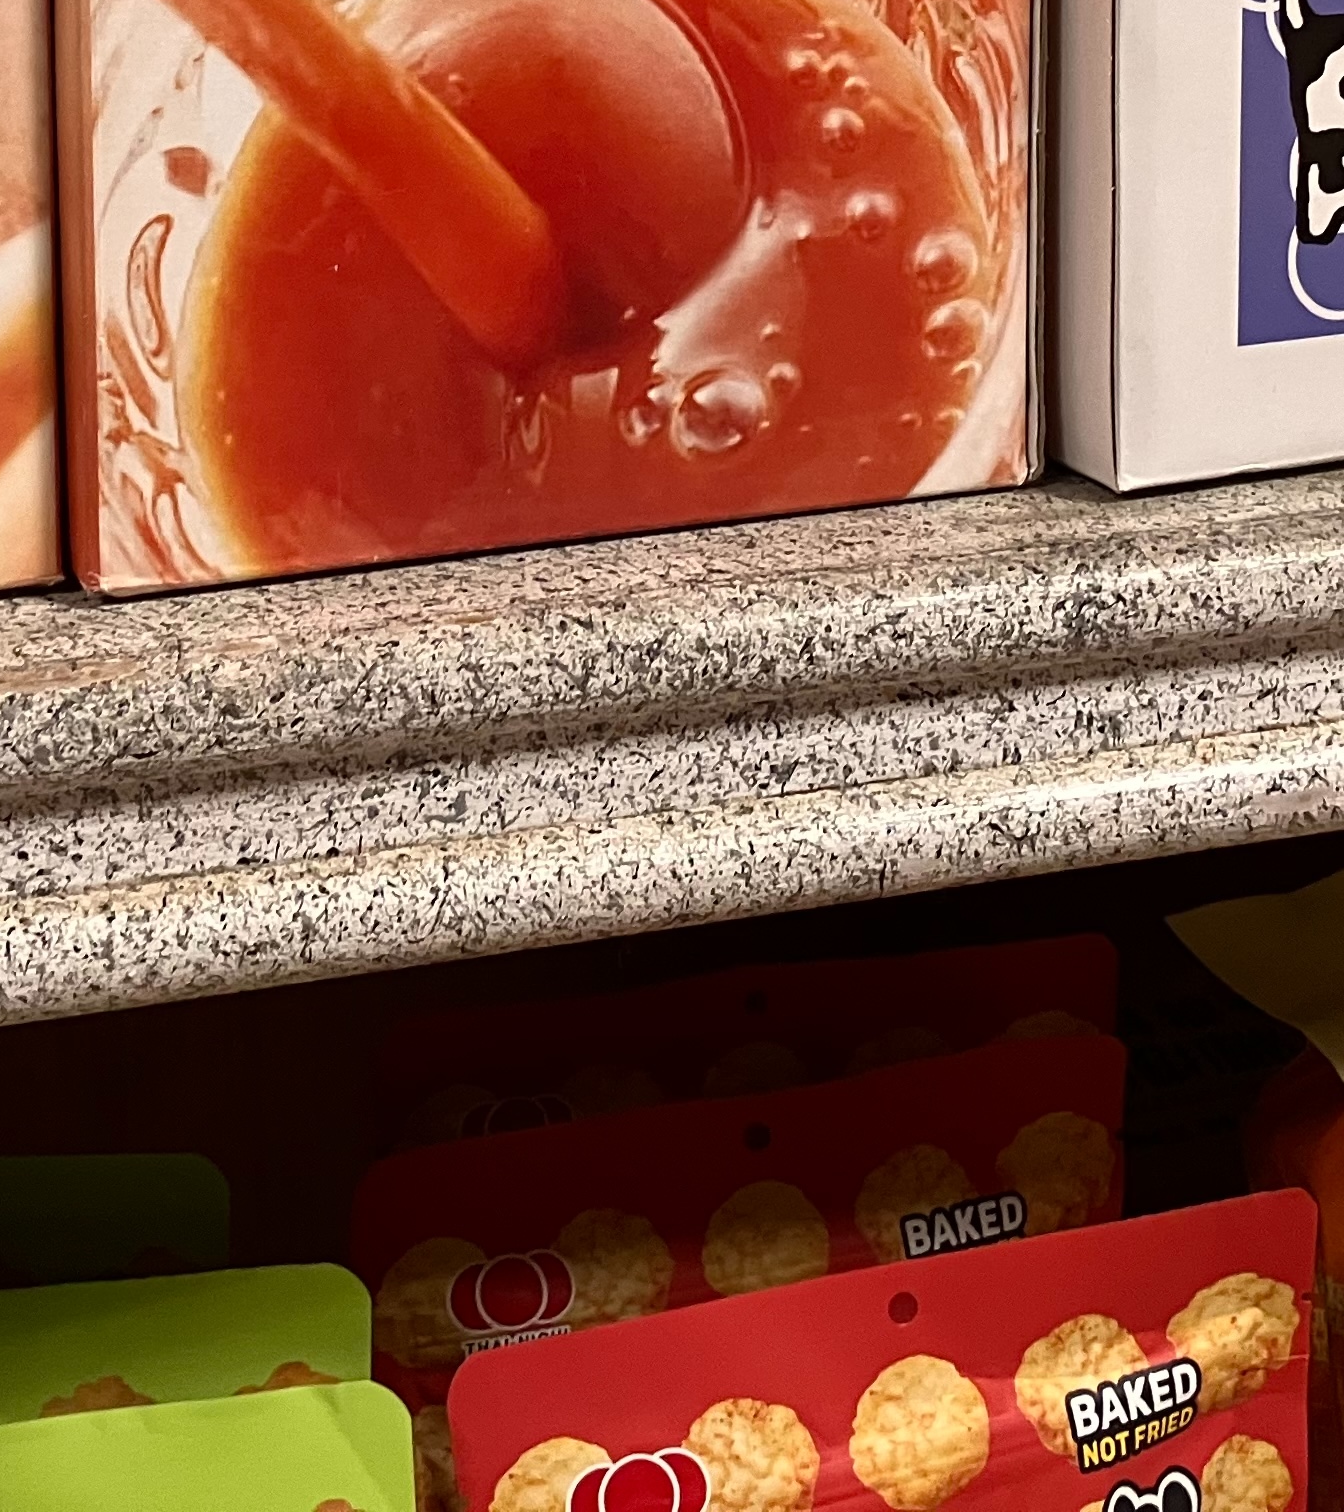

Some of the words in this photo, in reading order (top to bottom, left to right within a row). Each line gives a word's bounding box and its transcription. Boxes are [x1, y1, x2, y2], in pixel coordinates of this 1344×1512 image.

[903, 1194, 1024, 1258] BAKED
[1069, 1362, 1199, 1439] BAKED
[1082, 1430, 1130, 1469] NOT
[1133, 1406, 1194, 1451] FRIED
